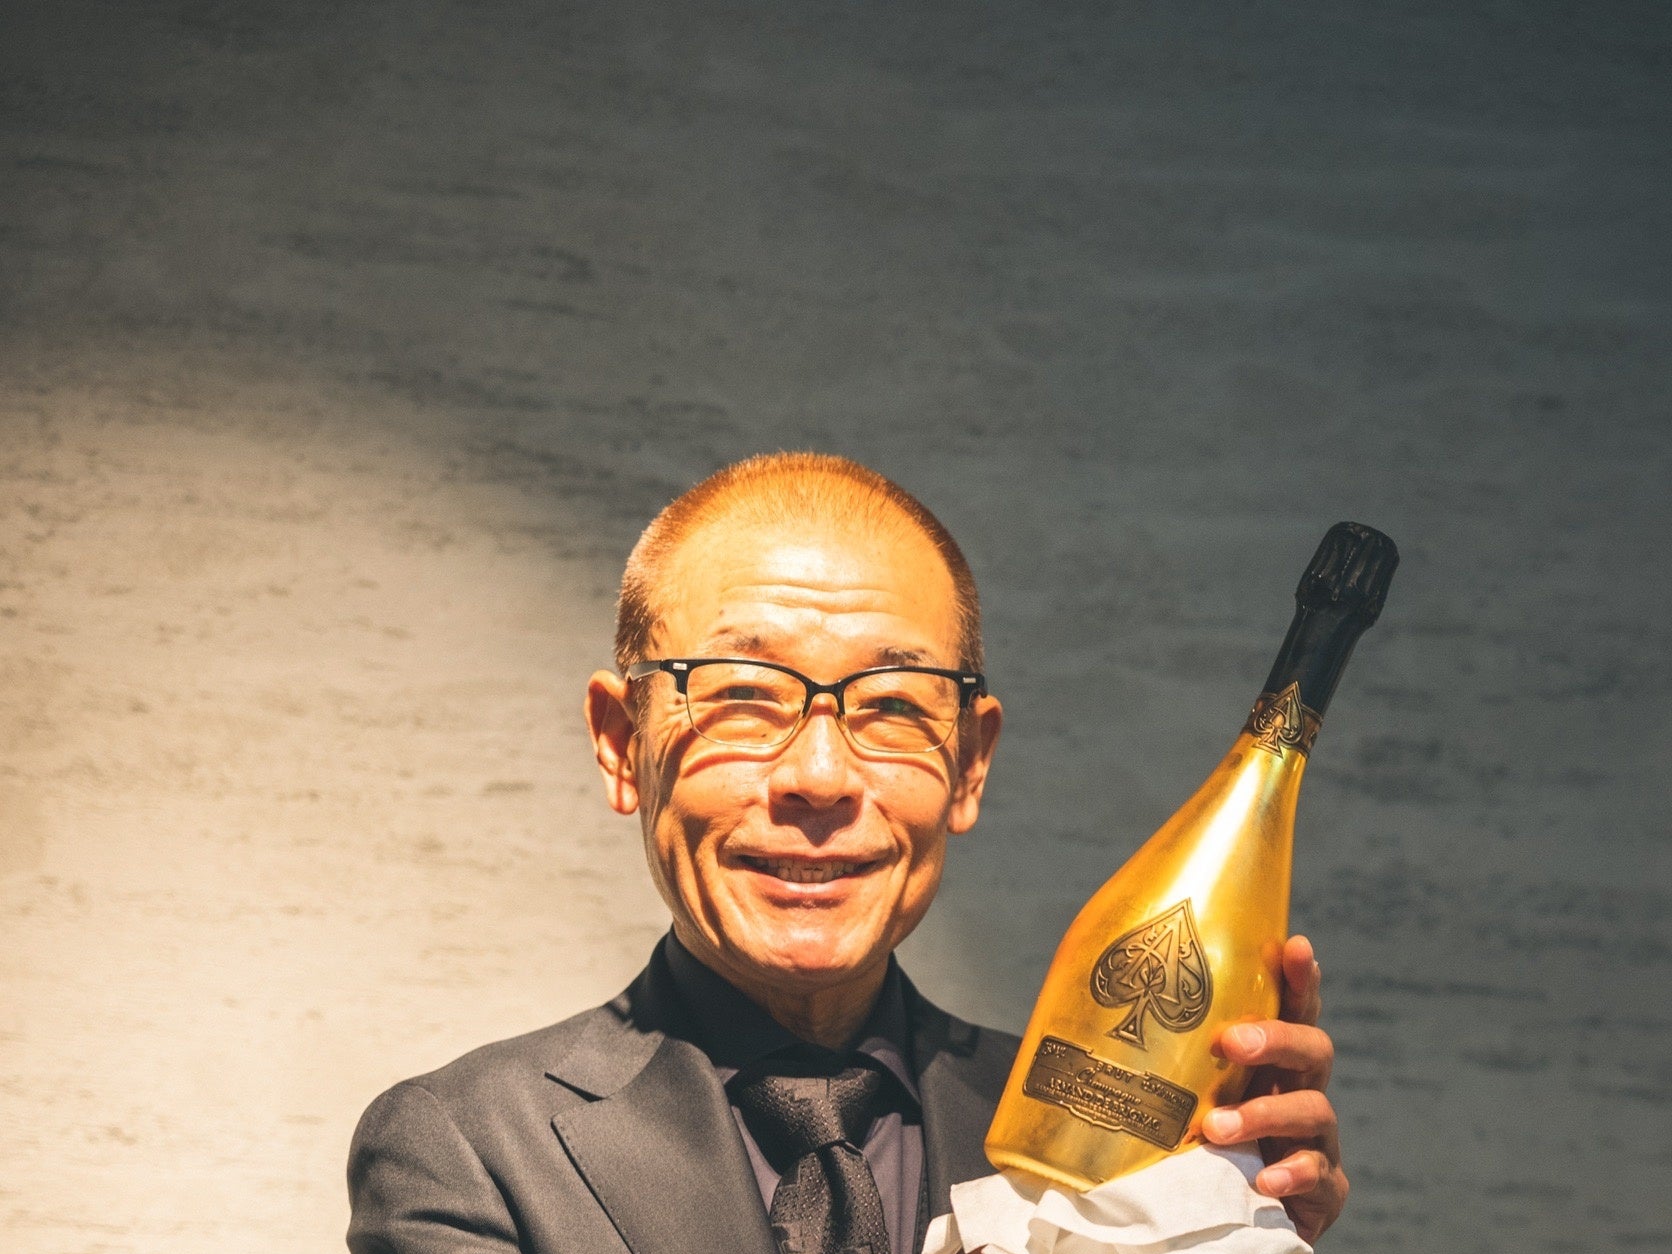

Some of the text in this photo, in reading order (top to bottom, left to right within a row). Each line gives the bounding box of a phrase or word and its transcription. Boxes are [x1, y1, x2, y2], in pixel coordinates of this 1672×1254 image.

[1095, 1061, 1135, 1083] BRUT
[1050, 1076, 1094, 1102] ARMAND
[1095, 1093, 1111, 1110] DE
[1112, 1099, 1161, 1131] BRIGNAC
